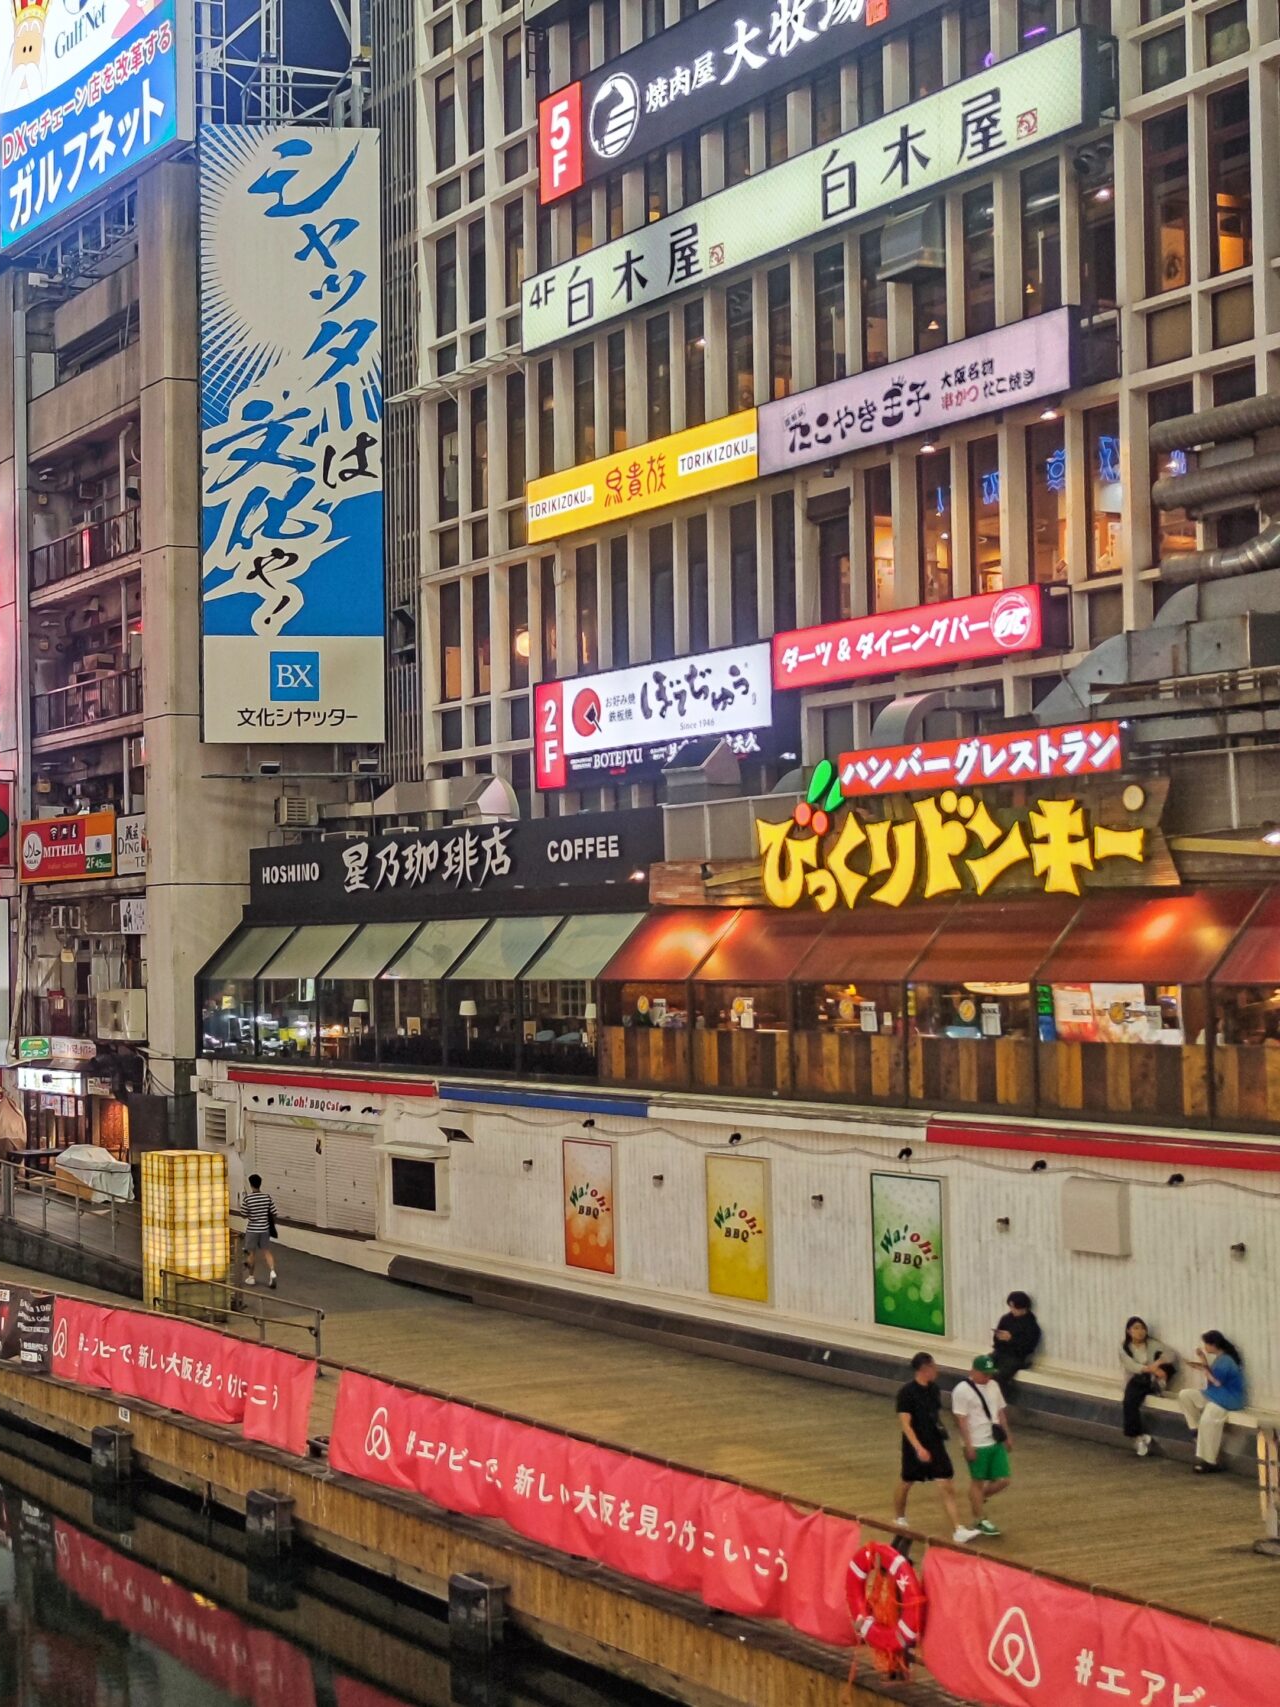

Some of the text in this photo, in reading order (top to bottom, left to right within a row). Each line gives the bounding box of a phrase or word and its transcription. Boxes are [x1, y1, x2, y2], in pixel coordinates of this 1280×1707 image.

[2, 20, 172, 168] DXでチェーン店を改革する
[645, 51, 718, 114] 焼肉屋
[9, 77, 165, 232] ガルフネット
[821, 87, 1009, 221] 白木屋
[529, 223, 703, 328] 4F 白木屋
[941, 358, 994, 390] 大阪名物
[789, 376, 931, 452] たこやき王子
[679, 439, 749, 472] TORIKIZOKU
[529, 489, 587, 519] TORIKIZOKU
[781, 640, 833, 673] ダーツ
[837, 638, 852, 662] &
[856, 615, 990, 660] ダイニングバー
[275, 665, 314, 688] BX
[605, 693, 637, 708] お好み焼
[608, 709, 634, 723] 鉄板焼
[679, 717, 715, 731] Since 1946
[592, 748, 643, 768] BOTEJYU
[841, 729, 1121, 788] ハンバーグレストラン
[43, 843, 84, 858] MITHILA
[134, 855, 146, 868] TE
[341, 825, 514, 893] 星乃珈琲店
[547, 835, 619, 862] COFFEE
[756, 791, 1145, 912] びっくりドンキー
[86, 858, 95, 869] 2F
[261, 861, 320, 884] HOSHINO
[309, 1099, 326, 1111] BBQ
[578, 1205, 600, 1220] BBQ
[725, 1227, 749, 1242] BBQ
[893, 1252, 923, 1269] BBQ
[1075, 1648, 1217, 1707] #エアビ
